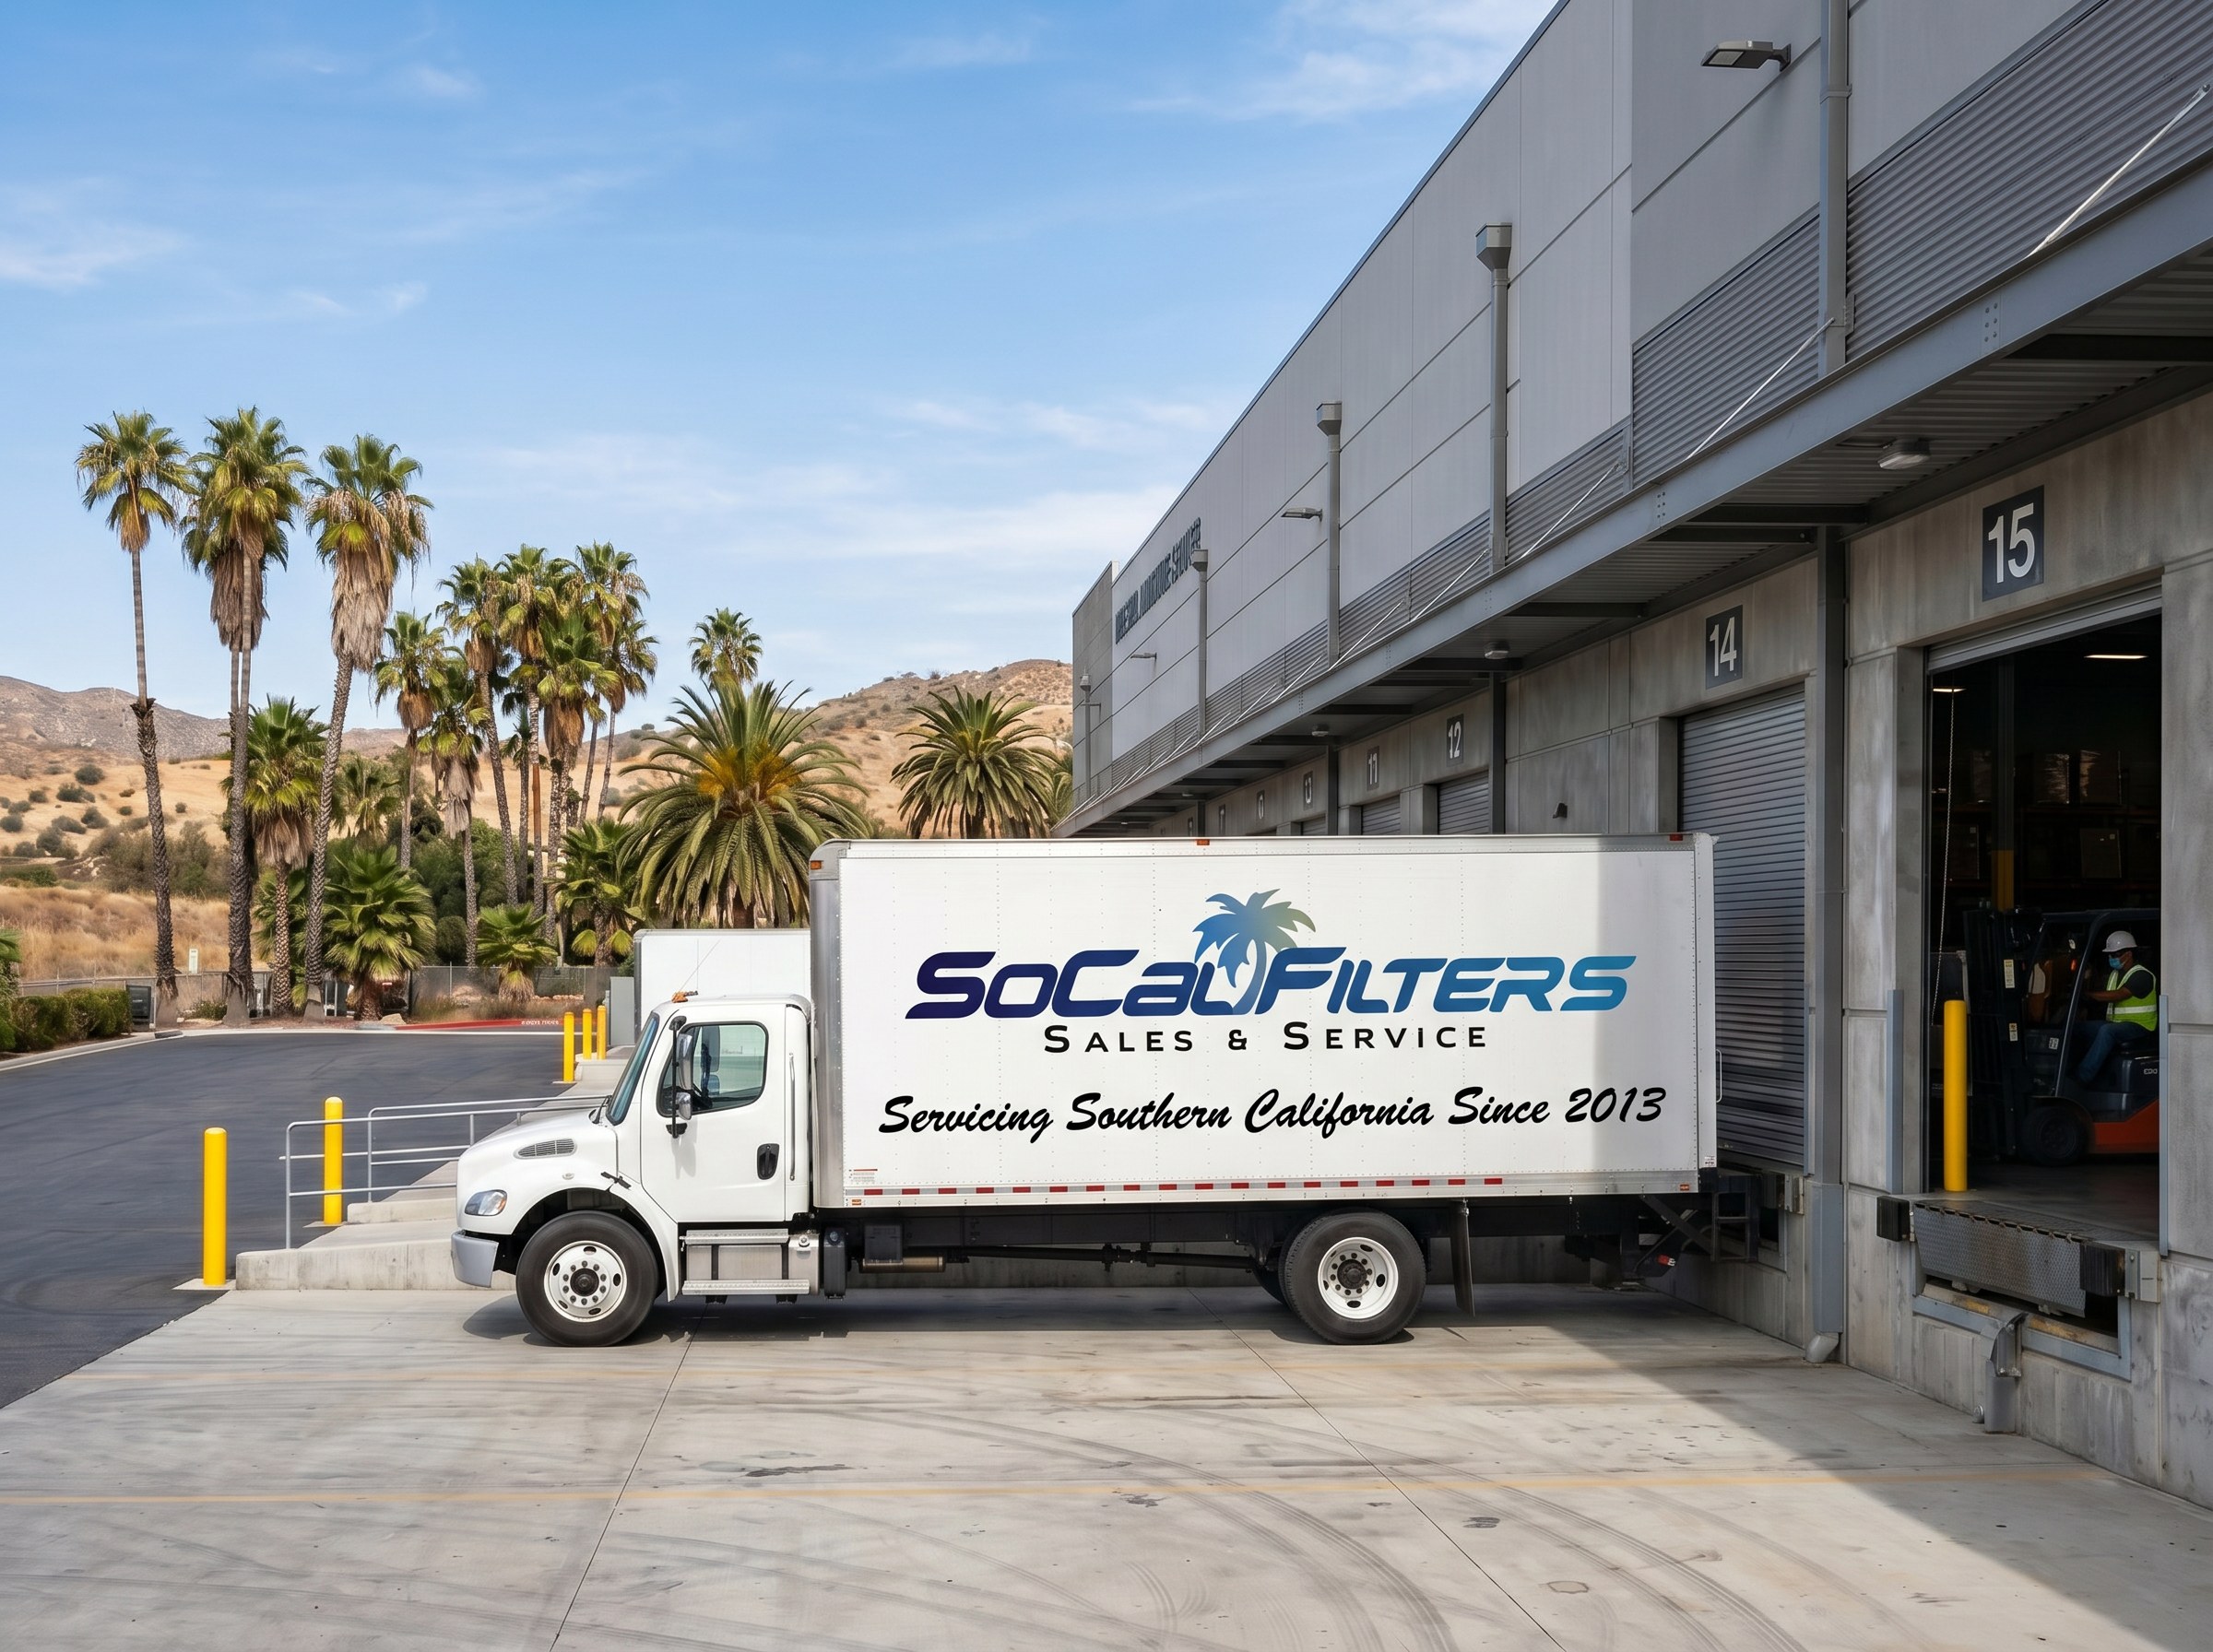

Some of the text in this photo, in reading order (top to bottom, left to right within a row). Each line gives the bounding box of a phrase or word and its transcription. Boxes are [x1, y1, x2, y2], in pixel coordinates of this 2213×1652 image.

[1988, 502, 2035, 584] 15
[1710, 617, 1737, 678] 14
[1448, 721, 1462, 760] 12
[1367, 752, 1379, 785] 11
[1227, 1029, 1248, 1051] &
[878, 1086, 1667, 1144] Servicing Southern California Since 2013
